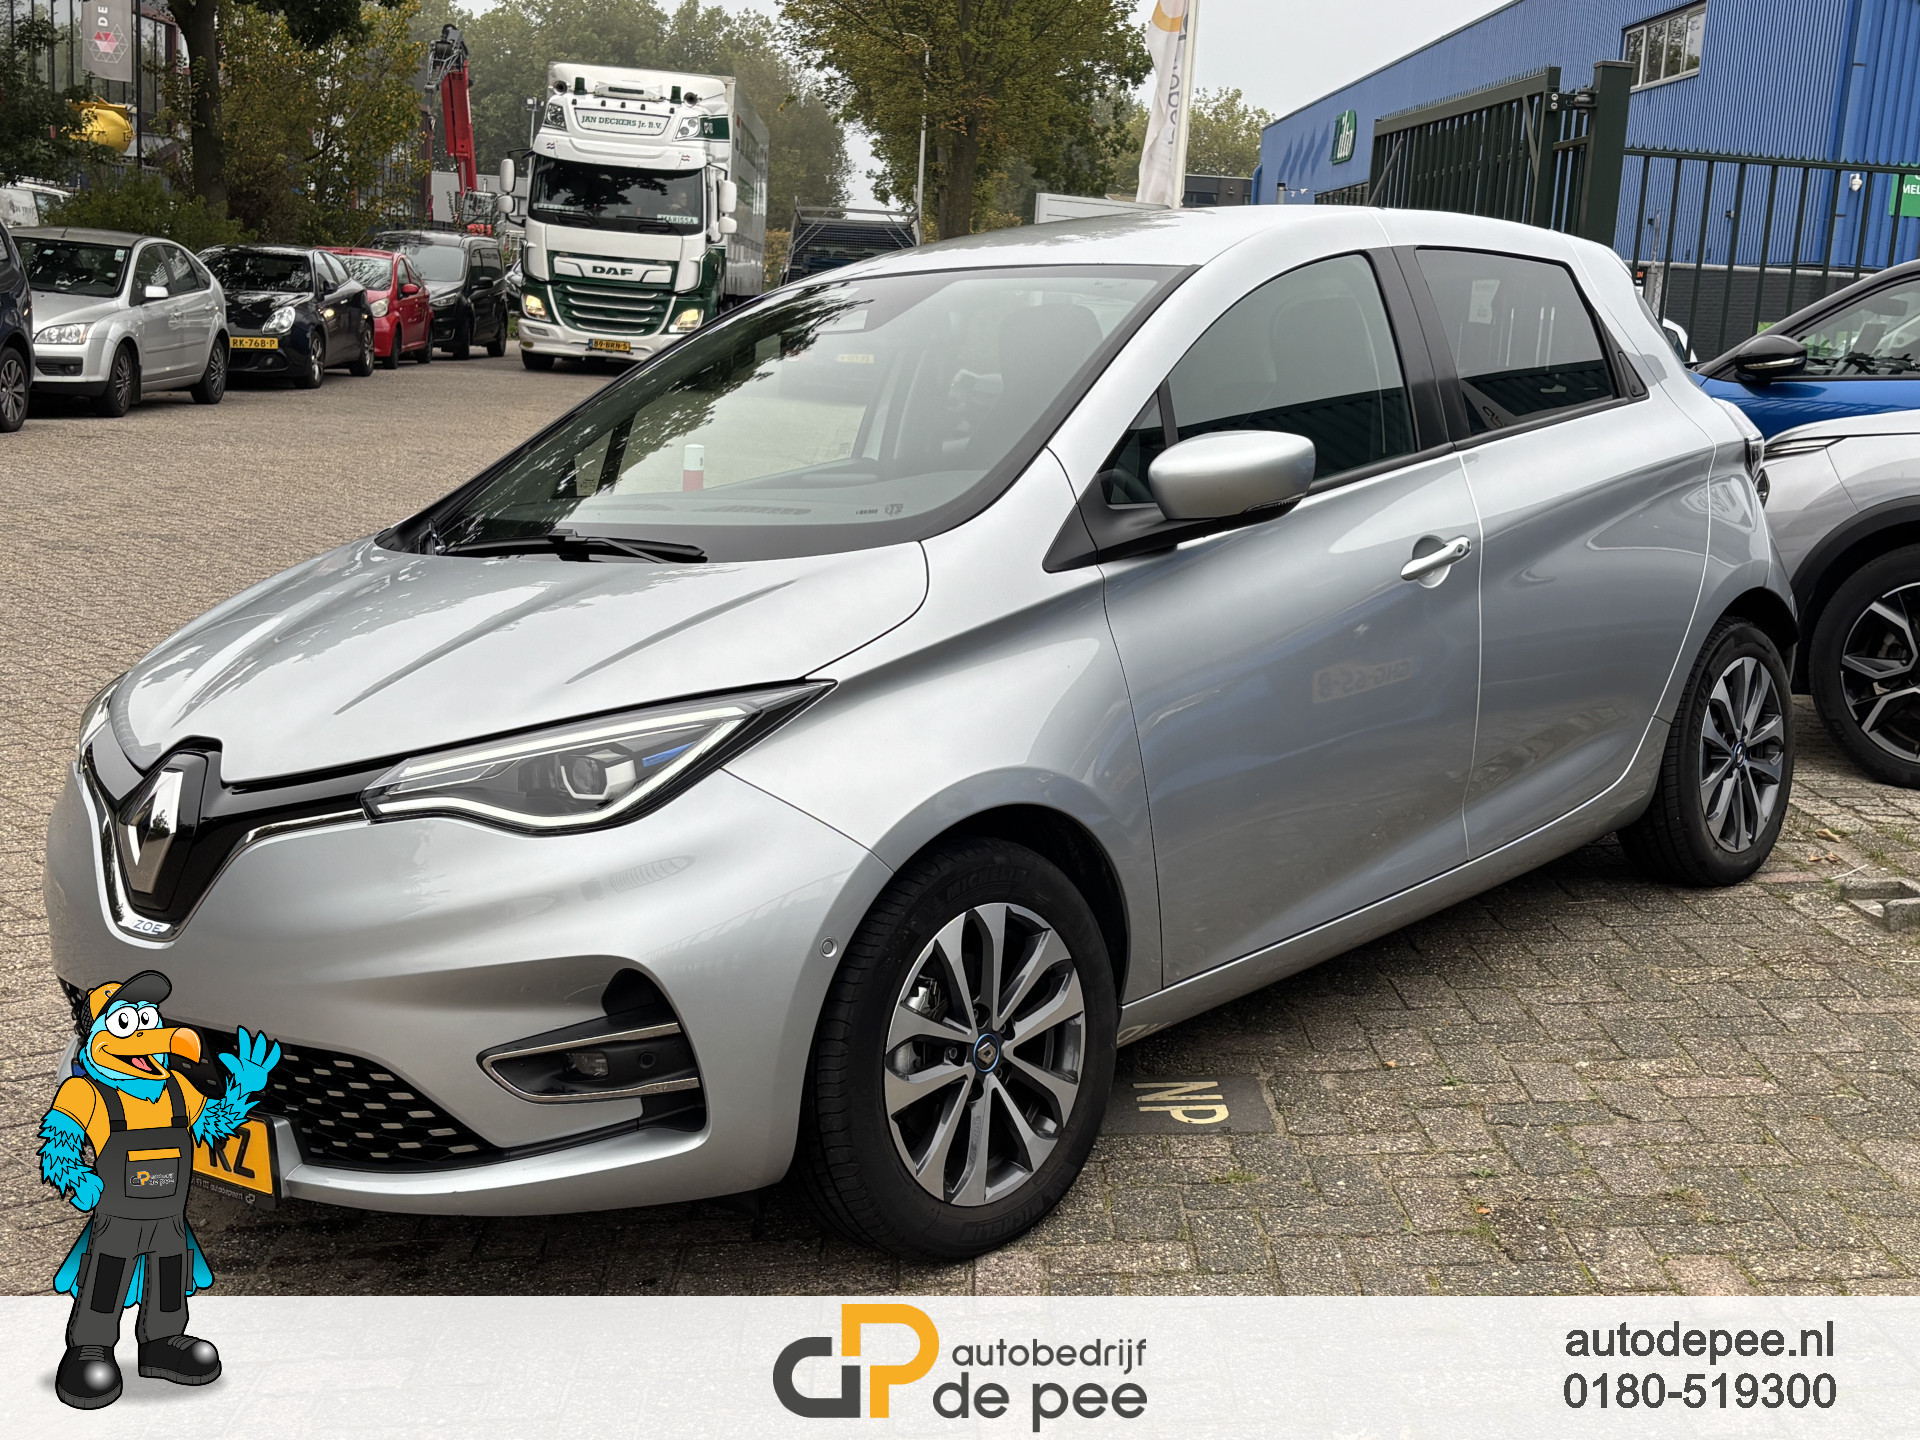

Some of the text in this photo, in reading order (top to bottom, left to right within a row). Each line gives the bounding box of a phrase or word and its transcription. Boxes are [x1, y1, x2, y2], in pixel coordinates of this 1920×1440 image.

[97, 6, 109, 27] DE
[581, 115, 662, 129] JAN DECKERS Jr. B.V.
[592, 265, 634, 276] DAF
[232, 338, 276, 348] RK-768-P
[133, 919, 163, 934] ZOE
[1132, 1081, 1230, 1125] NP
